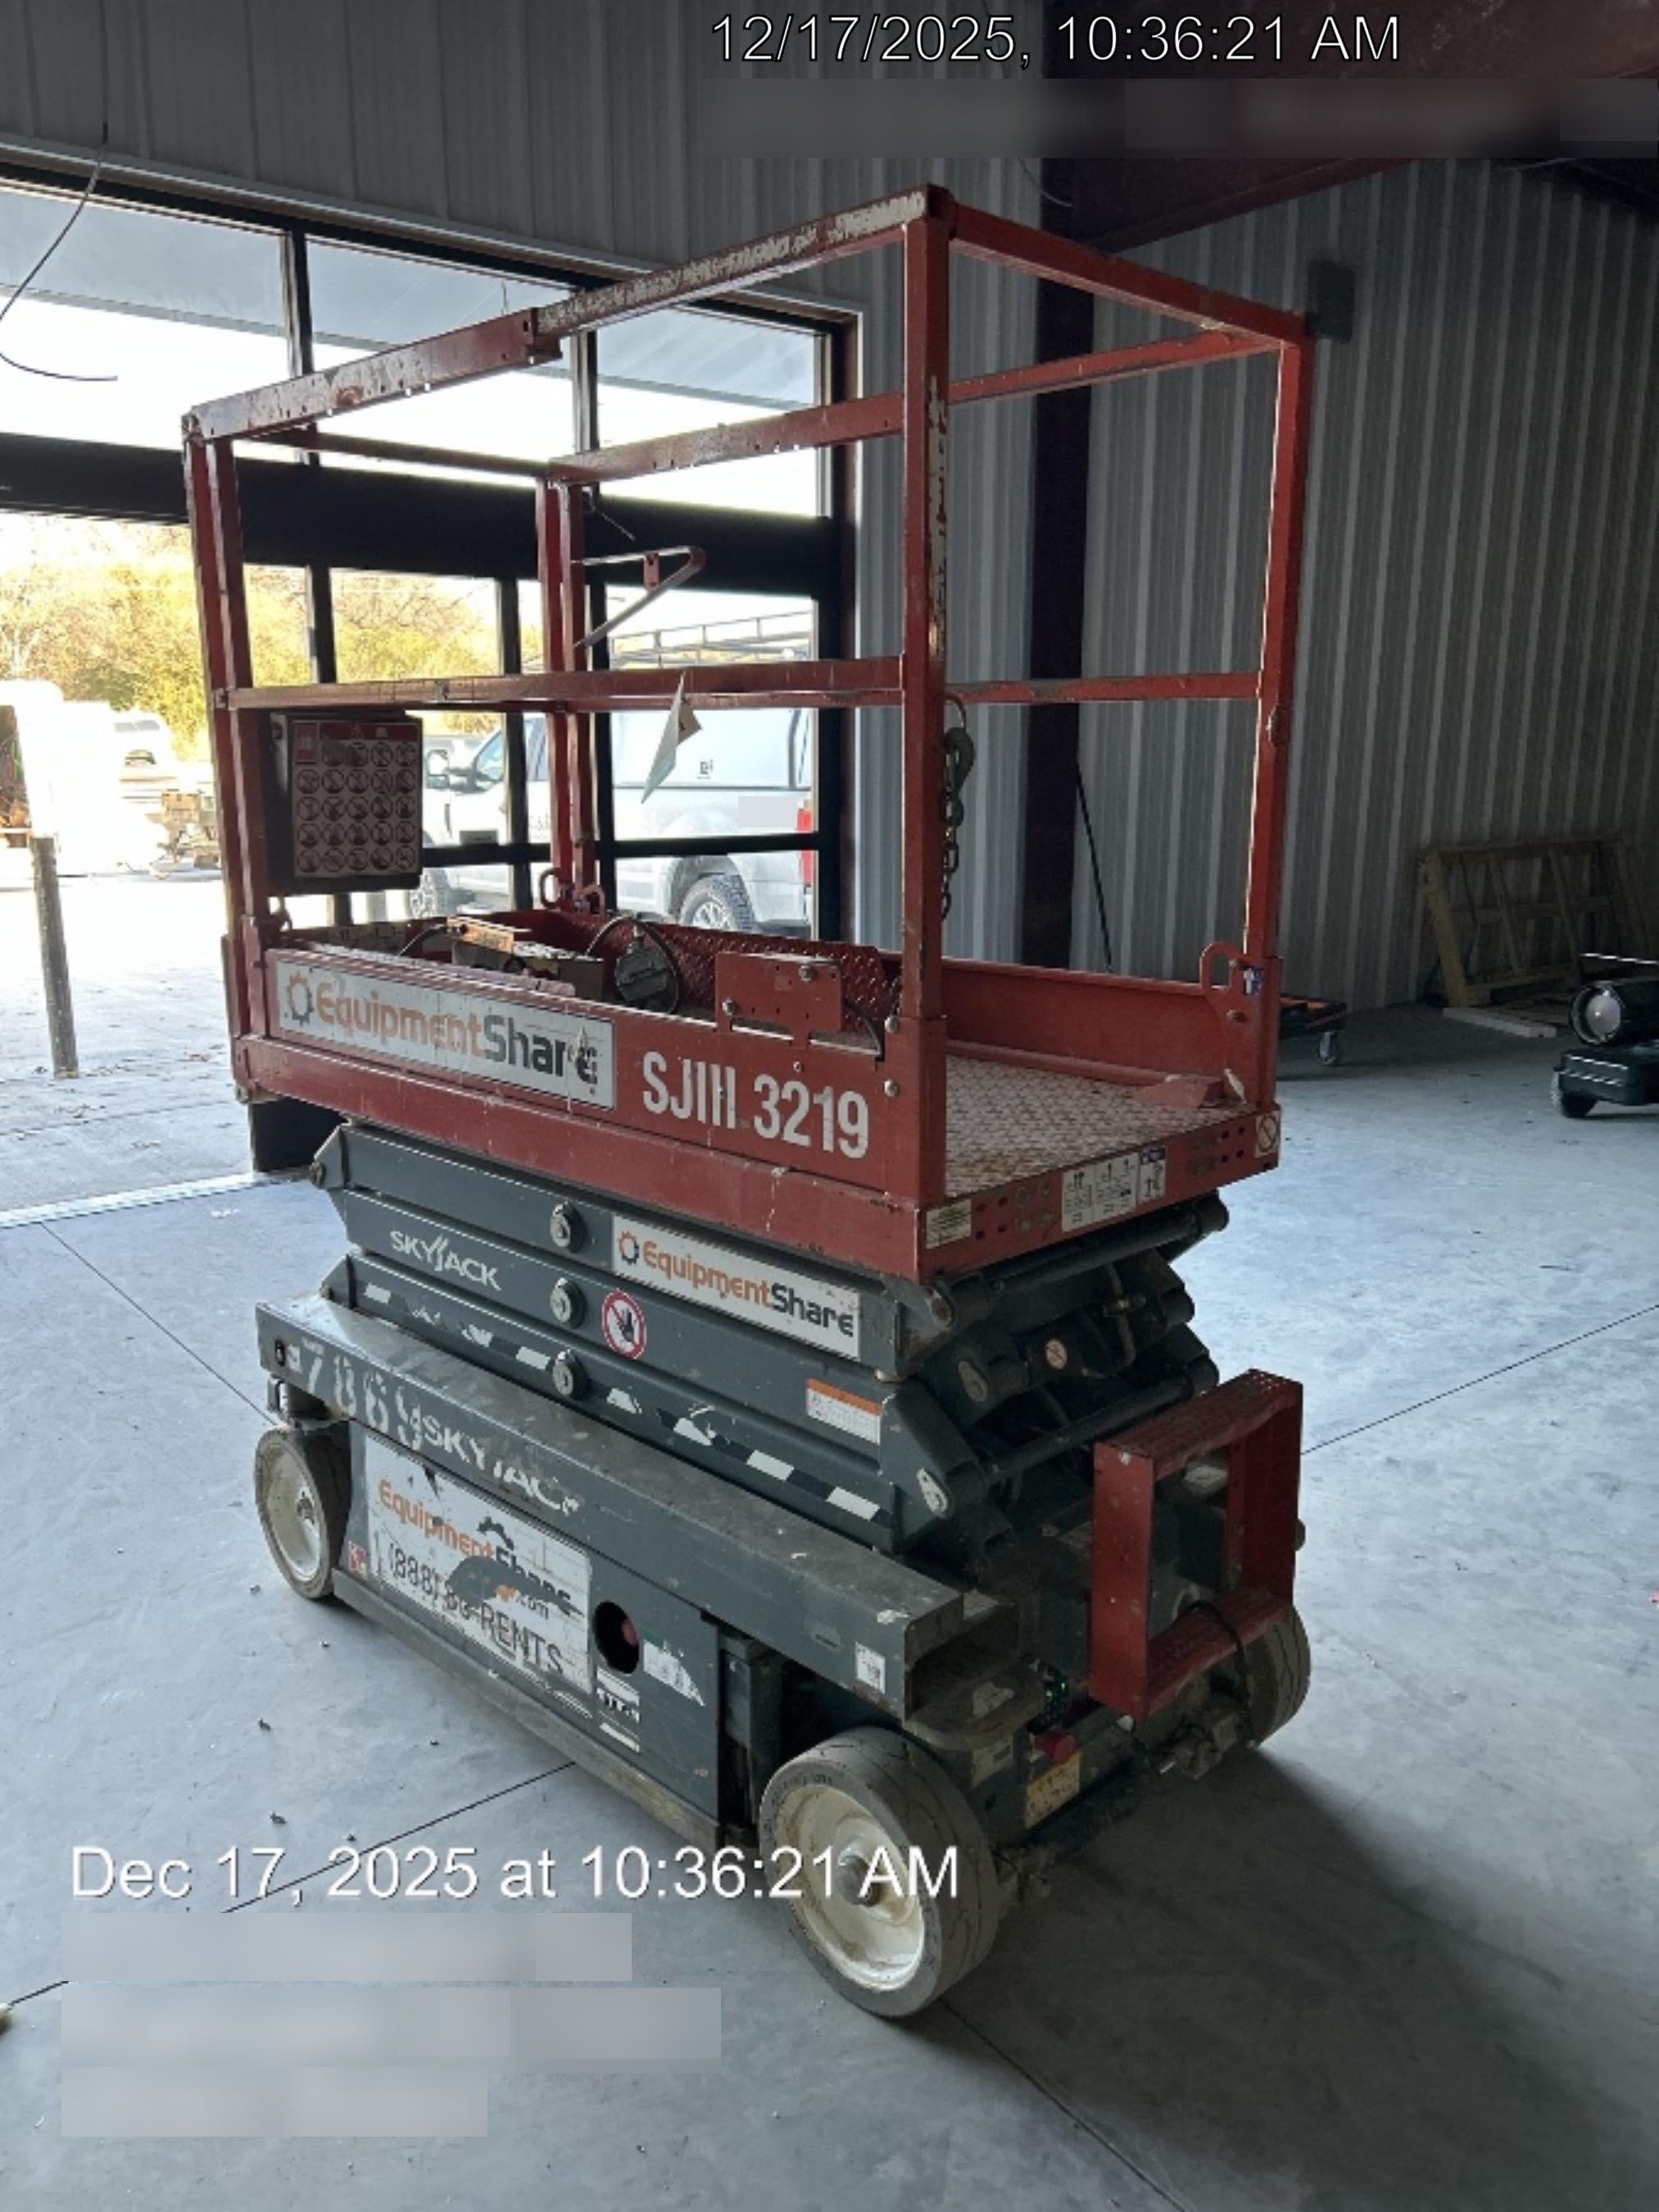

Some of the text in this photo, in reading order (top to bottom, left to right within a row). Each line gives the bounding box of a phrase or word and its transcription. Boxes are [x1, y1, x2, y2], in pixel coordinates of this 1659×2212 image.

[315, 985, 598, 1086] EquipmentShare
[753, 1073, 869, 1159] 3219
[389, 1230, 502, 1291] SKYJACK
[643, 1240, 854, 1338] EquipmentShare
